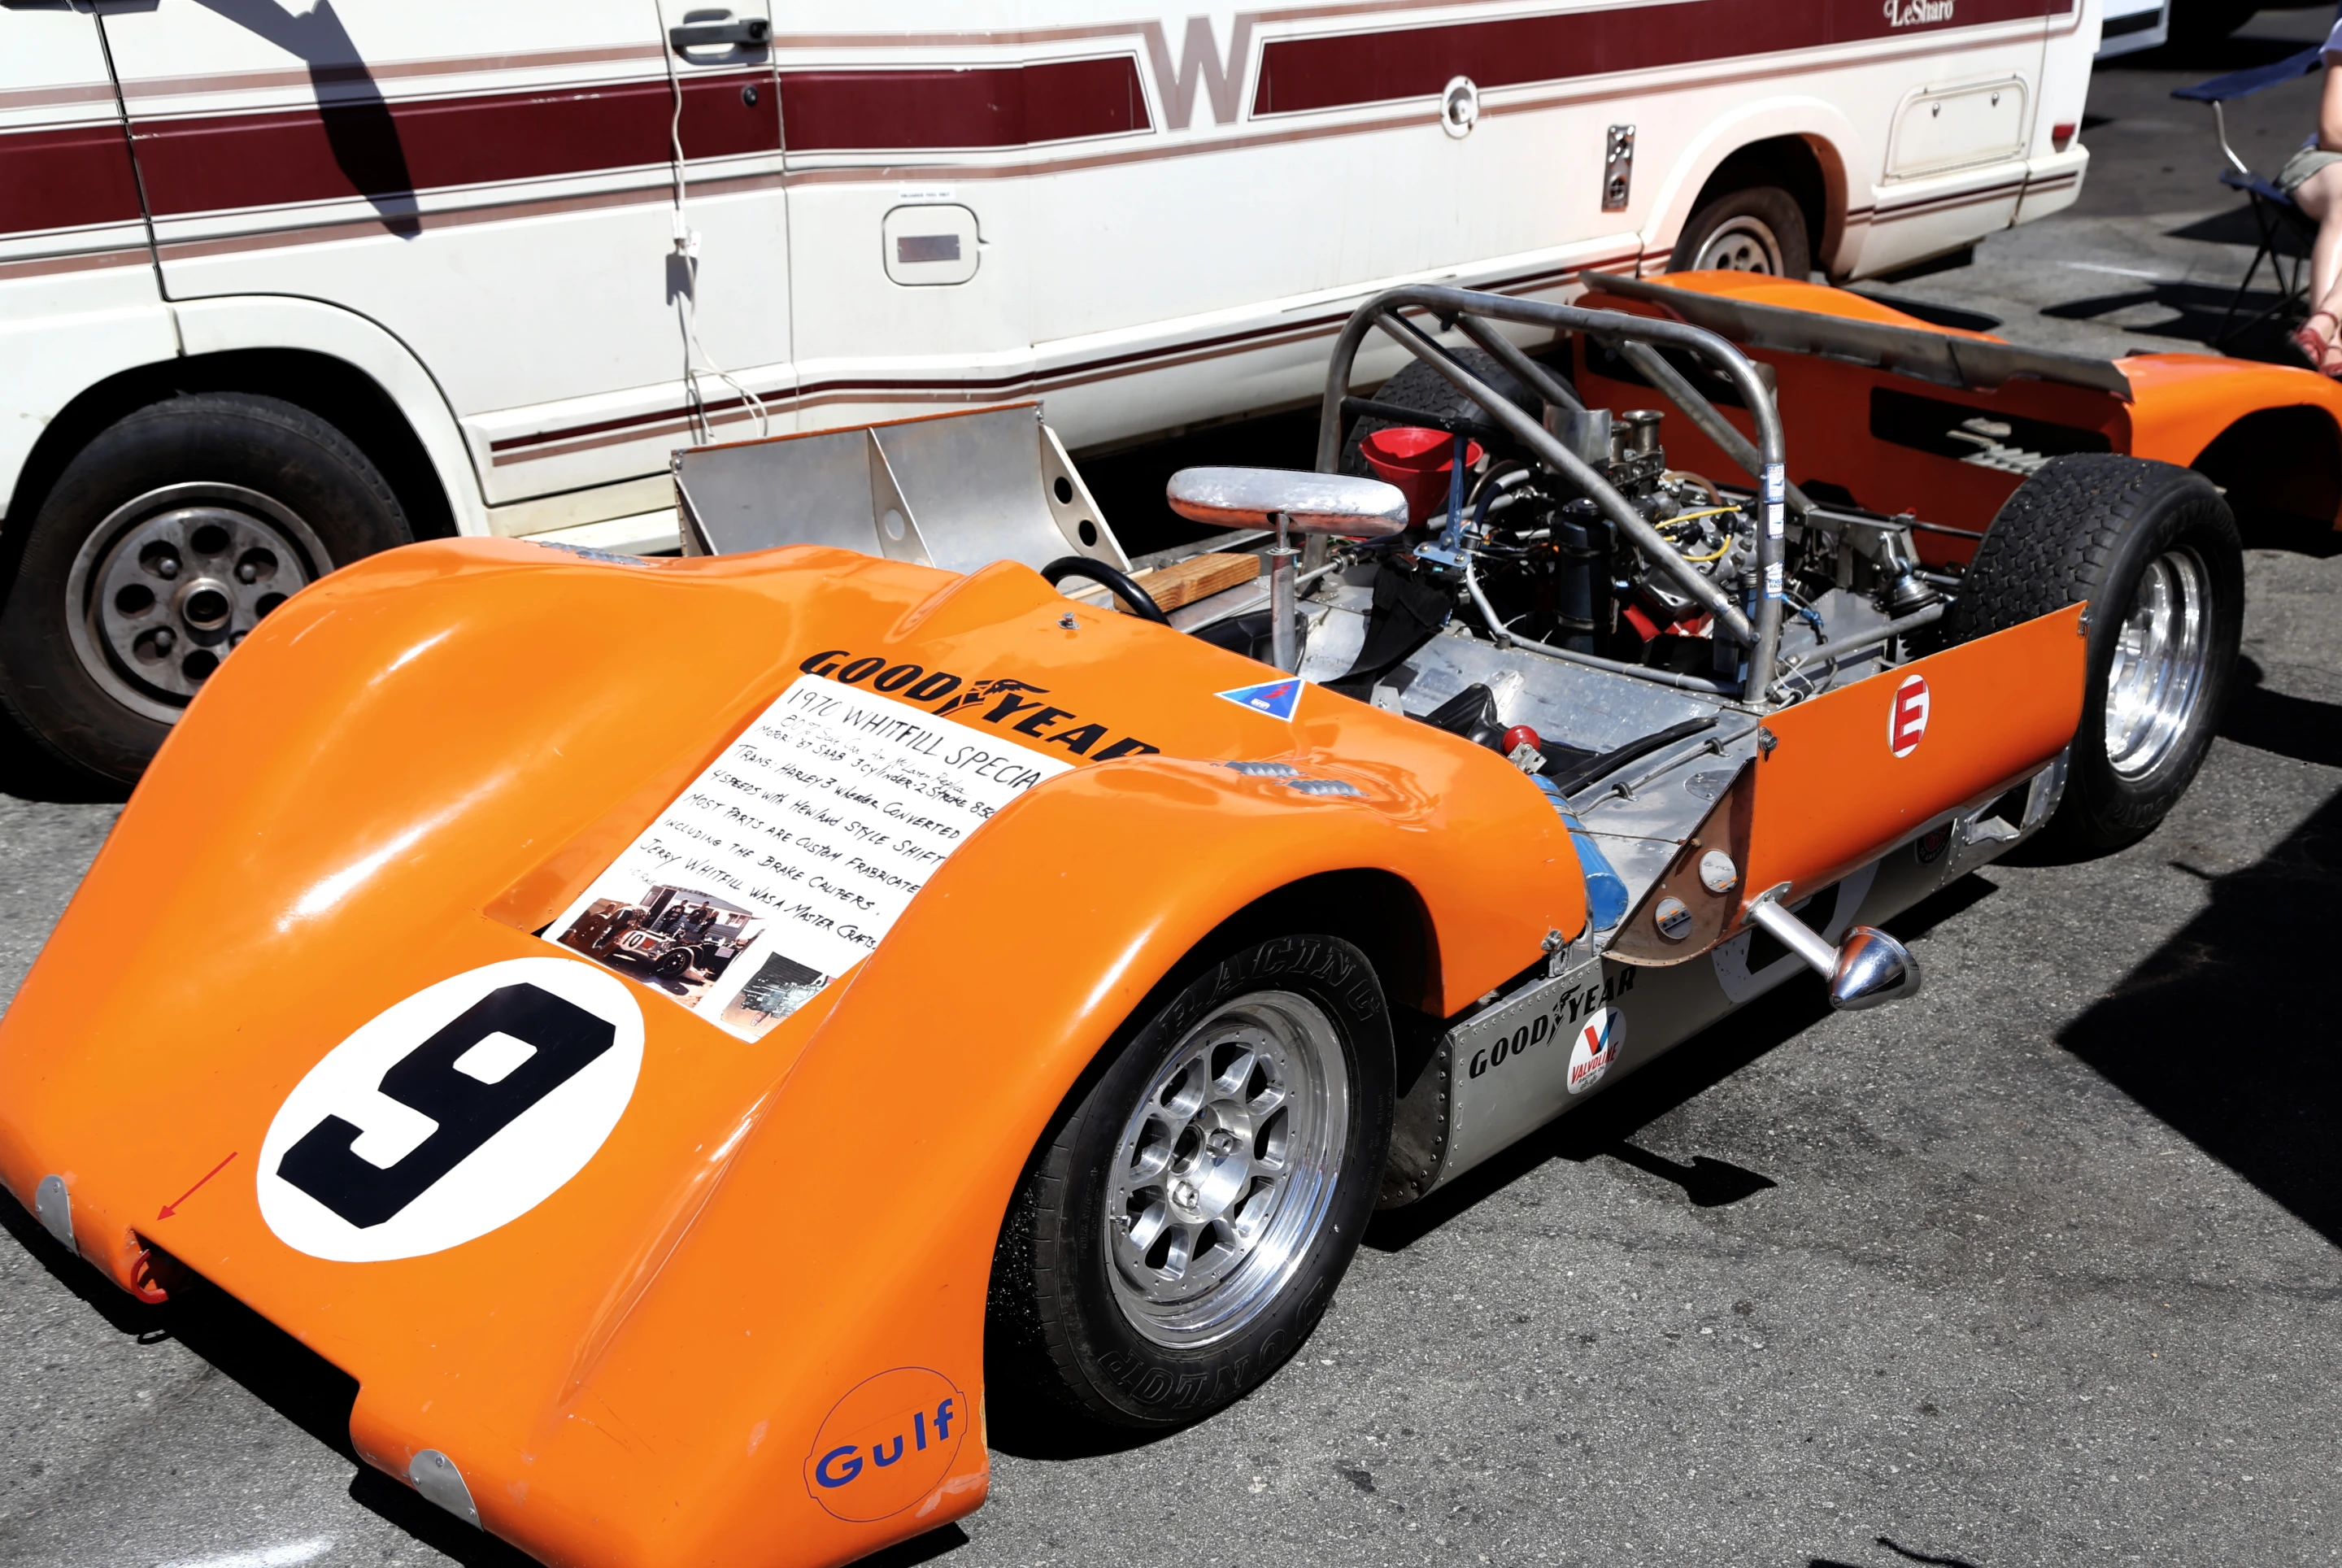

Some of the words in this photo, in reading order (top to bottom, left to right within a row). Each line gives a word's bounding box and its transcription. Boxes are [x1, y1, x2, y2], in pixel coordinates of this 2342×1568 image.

[1883, 0, 1954, 28] LeSharo
[786, 688, 843, 717] 1970
[842, 706, 938, 756] WHITFILL
[1892, 679, 1927, 753] E
[812, 744, 847, 761] SAAB
[774, 763, 822, 787] HARLEY
[882, 802, 960, 839] CONVERTED
[843, 821, 890, 845] STYLE
[663, 818, 722, 847] INCLUDING
[729, 843, 755, 858] THE
[757, 856, 805, 881] BRAKE
[683, 794, 725, 810] MOST
[764, 826, 793, 843] ARE
[795, 837, 843, 862] CUSTOM
[844, 856, 922, 894] FRABRICATE
[640, 838, 682, 868] JERRY
[684, 858, 743, 891] WHITFILL
[783, 904, 835, 931] MASTER
[836, 924, 876, 951] CRAFTS
[622, 931, 644, 947] 10
[1571, 1041, 1619, 1085] VALVOLINE
[276, 982, 616, 1230] 9
[816, 1398, 954, 1488] Gulf
